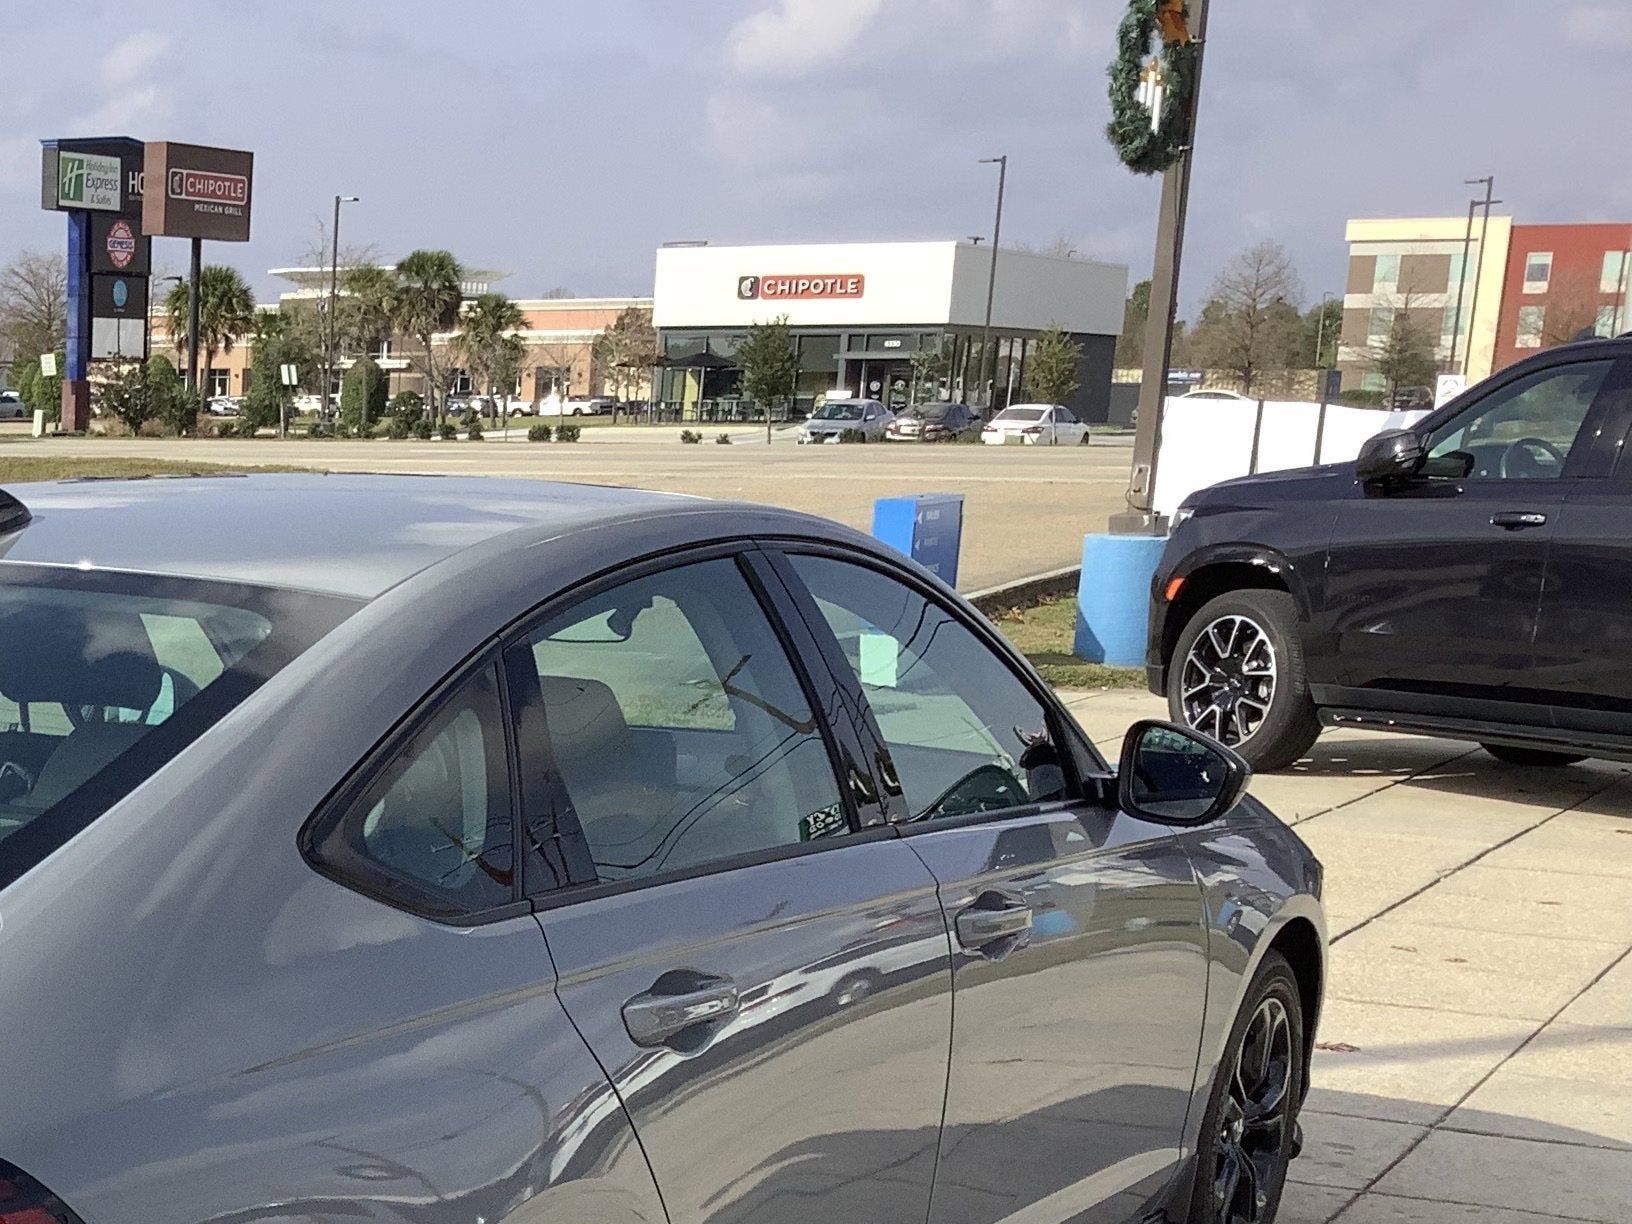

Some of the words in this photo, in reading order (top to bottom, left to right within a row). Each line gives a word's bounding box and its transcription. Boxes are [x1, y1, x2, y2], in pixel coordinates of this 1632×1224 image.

[85, 173, 119, 192] Express
[187, 177, 244, 197] CHIPOTLE
[194, 203, 223, 214] MEXICAN
[224, 206, 243, 216] GRILL
[763, 278, 859, 295] CHIPOTLE
